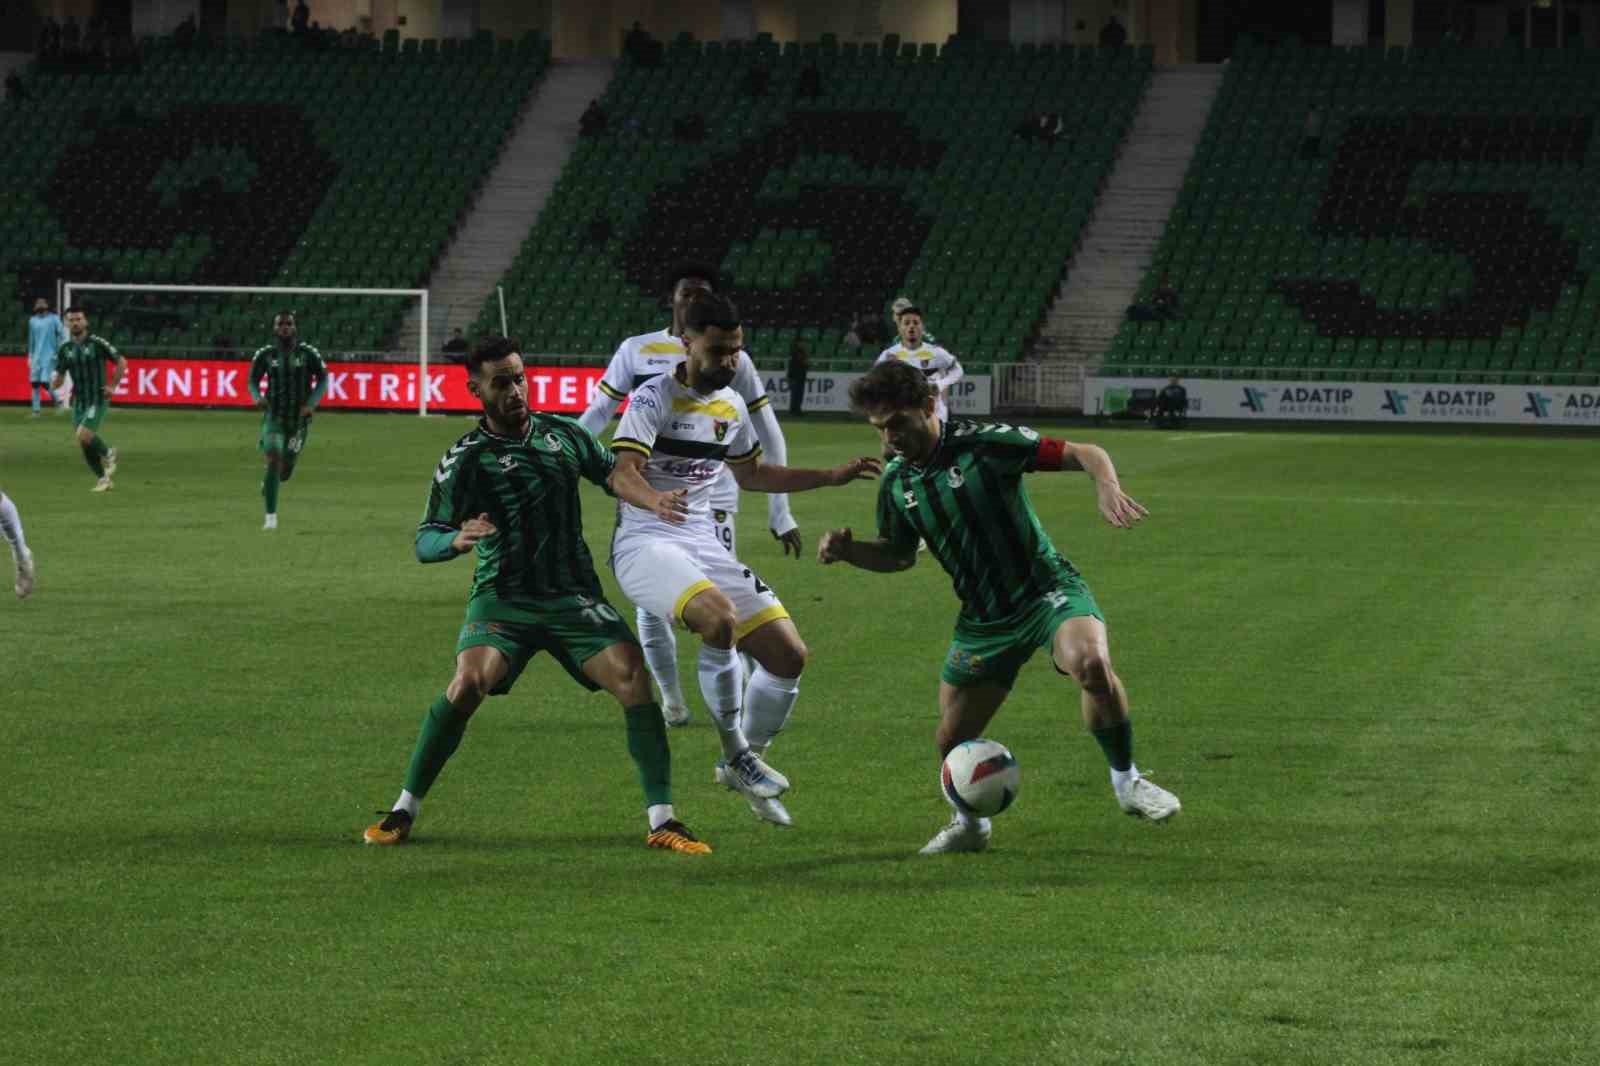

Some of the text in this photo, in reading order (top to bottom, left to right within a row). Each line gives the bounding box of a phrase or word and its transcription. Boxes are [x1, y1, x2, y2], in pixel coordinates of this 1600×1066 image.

[765, 377, 835, 393] ADTIP
[1280, 387, 1354, 403] ADATIP
[1422, 390, 1496, 406] ADATIP
